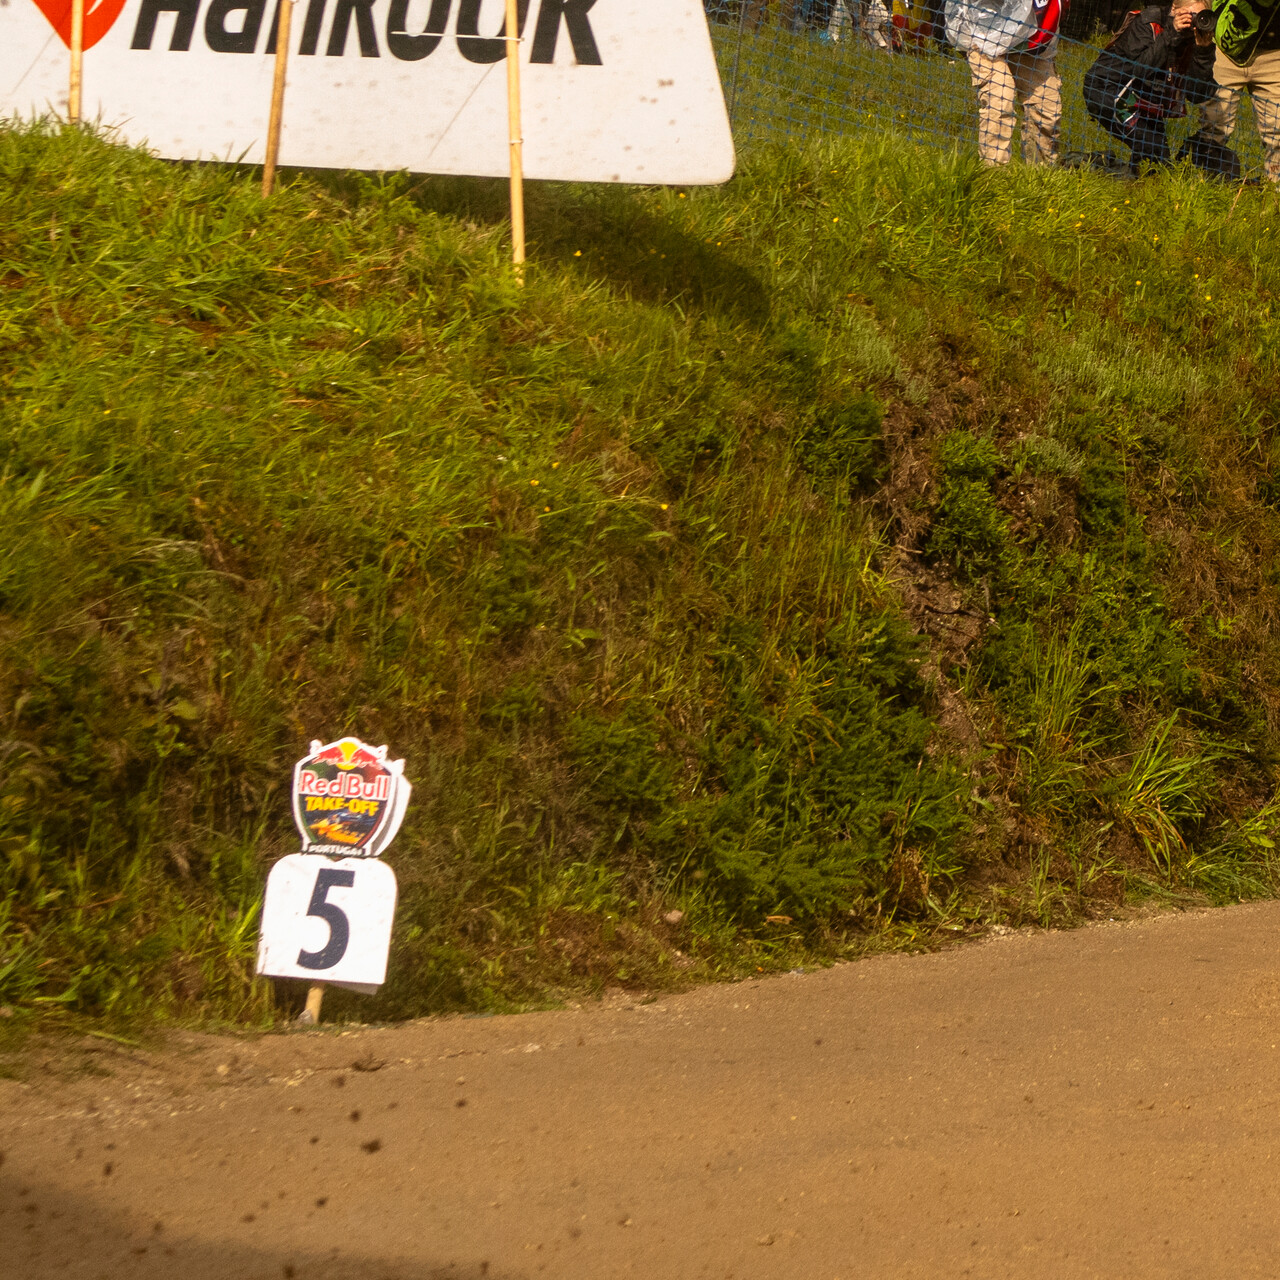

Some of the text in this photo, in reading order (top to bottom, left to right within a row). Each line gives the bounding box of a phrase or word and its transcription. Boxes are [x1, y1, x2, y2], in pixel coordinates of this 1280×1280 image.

[299, 770, 391, 800] Red Bull
[304, 796, 380, 817] TAKE-OFF
[296, 868, 356, 971] 5
